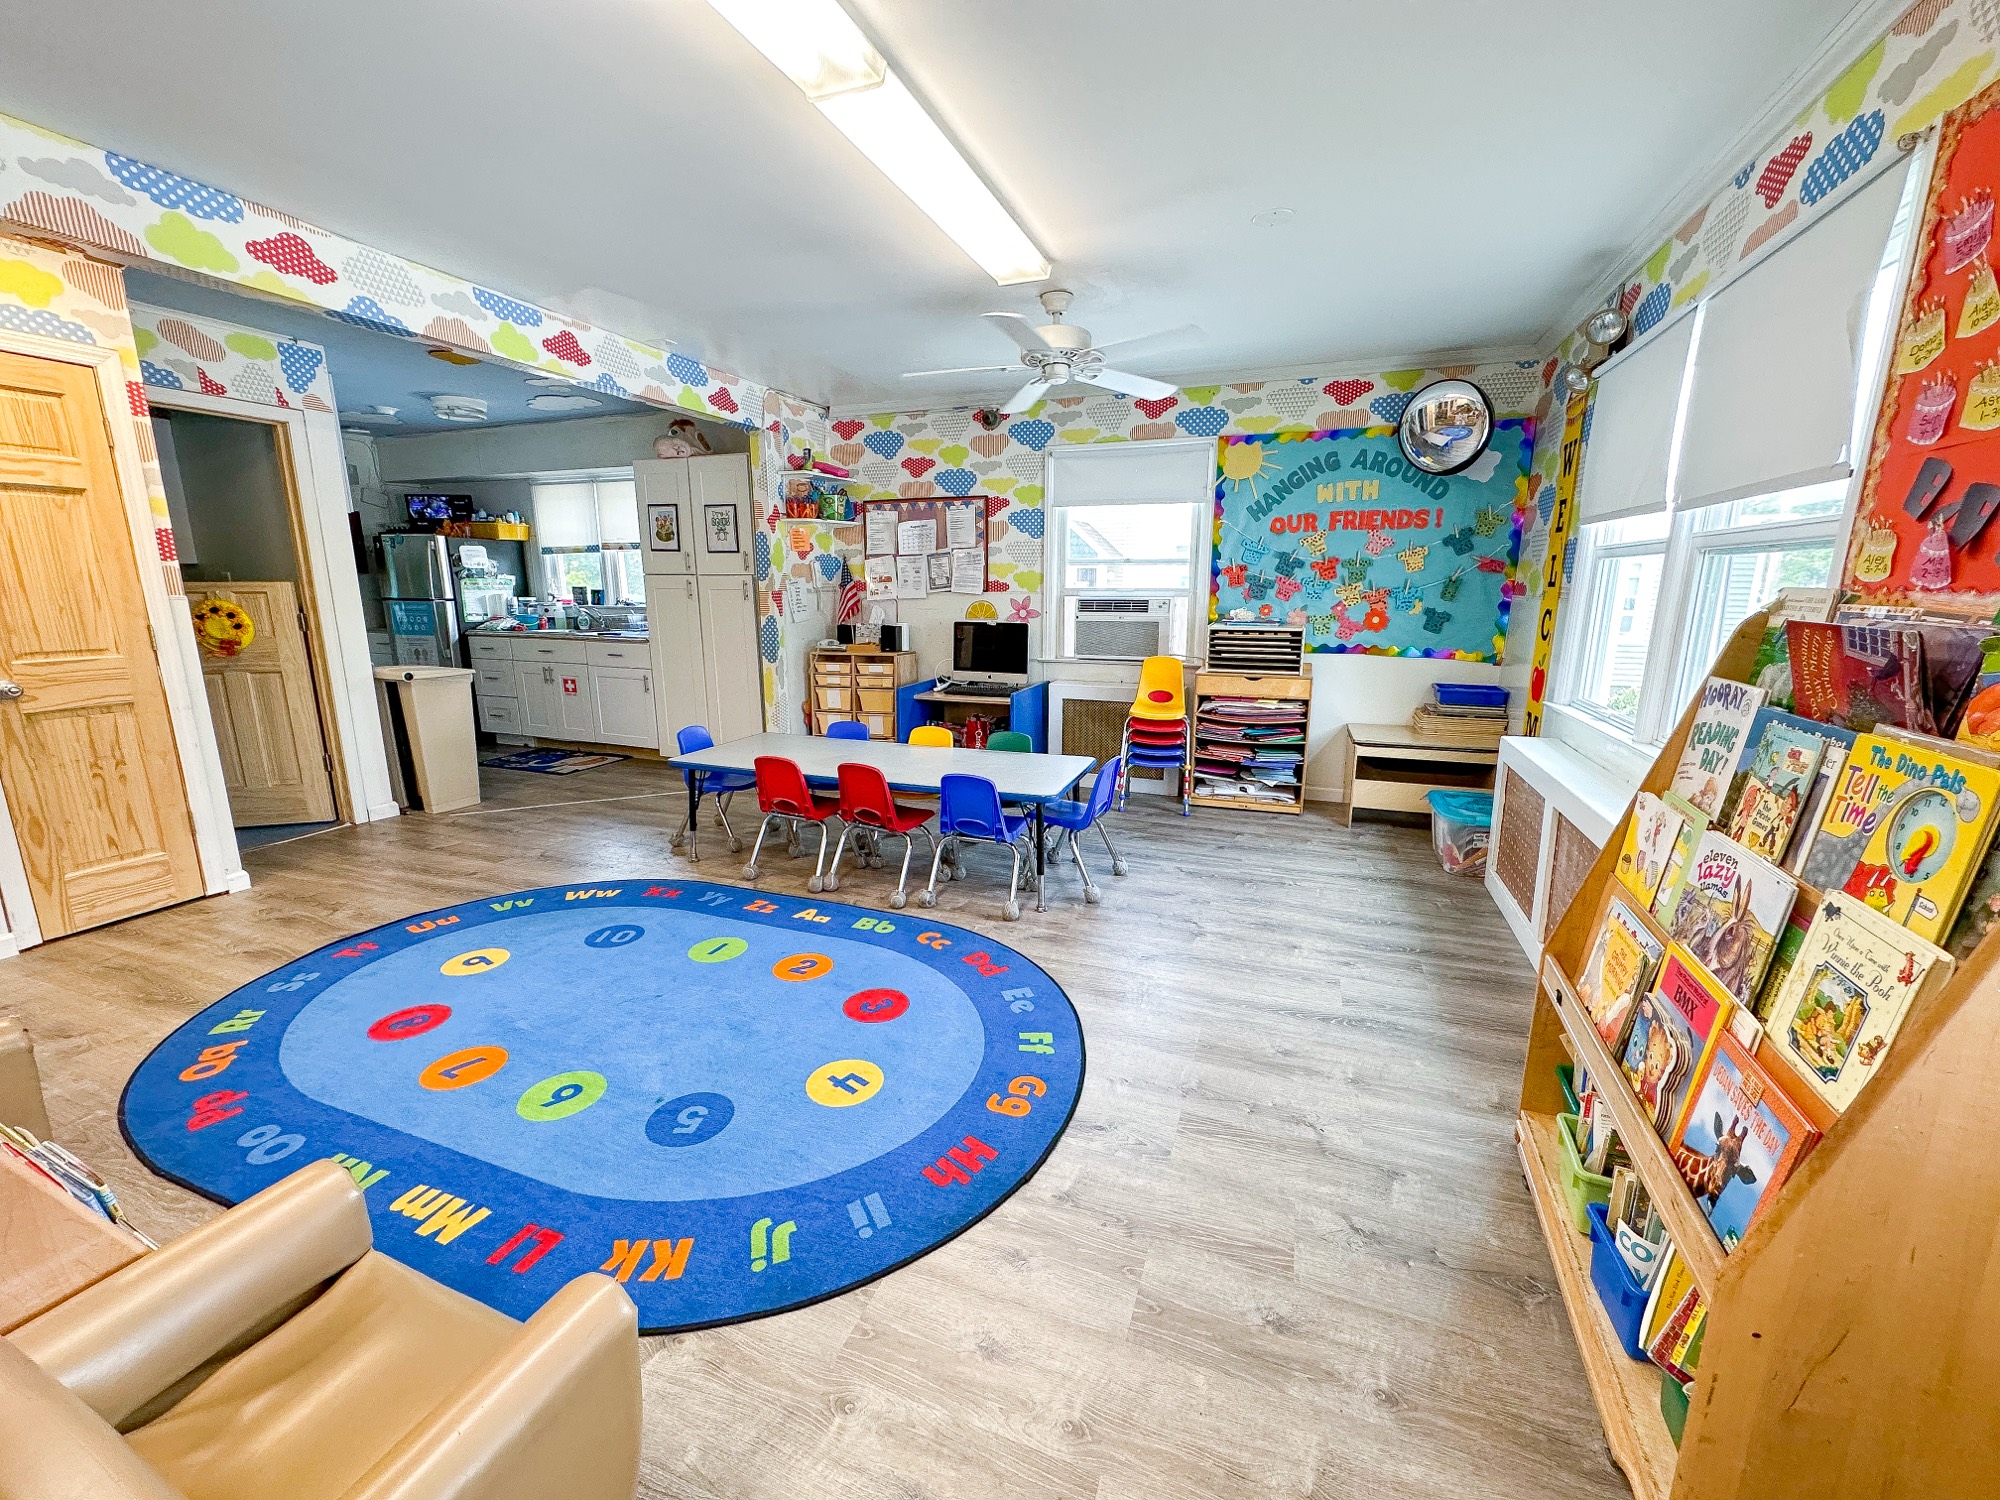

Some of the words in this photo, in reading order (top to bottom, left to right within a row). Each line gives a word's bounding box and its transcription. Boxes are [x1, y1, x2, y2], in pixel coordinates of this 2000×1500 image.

[1245, 450, 1341, 522] HANGING
[1350, 448, 1450, 501] AROUND
[1316, 479, 1380, 504] WITH
[1270, 509, 1318, 535] OUR
[1863, 554, 1886, 566] Alex
[1799, 628, 1812, 695] Dinosaurs
[1810, 631, 1825, 673] Merry
[1700, 683, 1748, 711] HOORAY
[1812, 675, 1825, 703] Say
[1810, 696, 1822, 719] Do
[1688, 721, 1739, 758] READING
[1700, 748, 1729, 776] DAY!
[1870, 744, 1892, 770] The
[1896, 753, 1927, 780] Dino
[1930, 764, 1966, 794] Pals
[1844, 764, 1880, 804] Tell
[1876, 784, 1895, 804] the
[1762, 800, 1772, 812] The
[1830, 795, 1877, 834] Time
[1911, 808, 1919, 817] 10
[1924, 799, 1932, 808] 11
[1940, 797, 1948, 807] 12
[1752, 818, 1768, 832] Games
[1756, 810, 1772, 824] Pirate
[1703, 849, 1739, 870] eleven
[1697, 862, 1736, 888] lazy
[1923, 872, 1930, 880] 5
[564, 888, 622, 902] Ww
[1699, 882, 1728, 899] llamas
[490, 898, 536, 912] Vv
[743, 898, 780, 914] Zz
[791, 908, 832, 925] Aa
[404, 914, 461, 935] Uu
[594, 928, 635, 944] 10
[850, 916, 897, 936] Bb
[331, 942, 380, 959] Tt
[916, 931, 953, 951] Cc
[790, 958, 822, 976] 2
[961, 951, 1010, 979] Dd
[1821, 933, 1850, 970] Winnie
[1850, 962, 1865, 981] the
[1866, 969, 1894, 1002] Pooh
[267, 971, 320, 994] Ss
[859, 997, 895, 1014] 3
[1000, 986, 1037, 1016] Ee
[1673, 984, 1698, 1022] BMX
[207, 1008, 267, 1037] Rr
[387, 1012, 433, 1034] 8
[1018, 1031, 1056, 1056] Ff
[177, 1039, 250, 1084] Qq
[438, 1056, 487, 1081] 7
[826, 1071, 870, 1096] 4
[986, 1076, 1048, 1117] Gg
[187, 1089, 250, 1132] Pp
[672, 1105, 710, 1136] 5
[1730, 1086, 1752, 1122] SAVES
[1750, 1110, 1768, 1140] THE
[1763, 1128, 1782, 1156] DAY
[236, 1123, 305, 1166] Oo
[921, 1135, 1000, 1189] Hh
[388, 1184, 493, 1246] Mm
[748, 1217, 798, 1274] Jj
[599, 1236, 695, 1284] Kk
